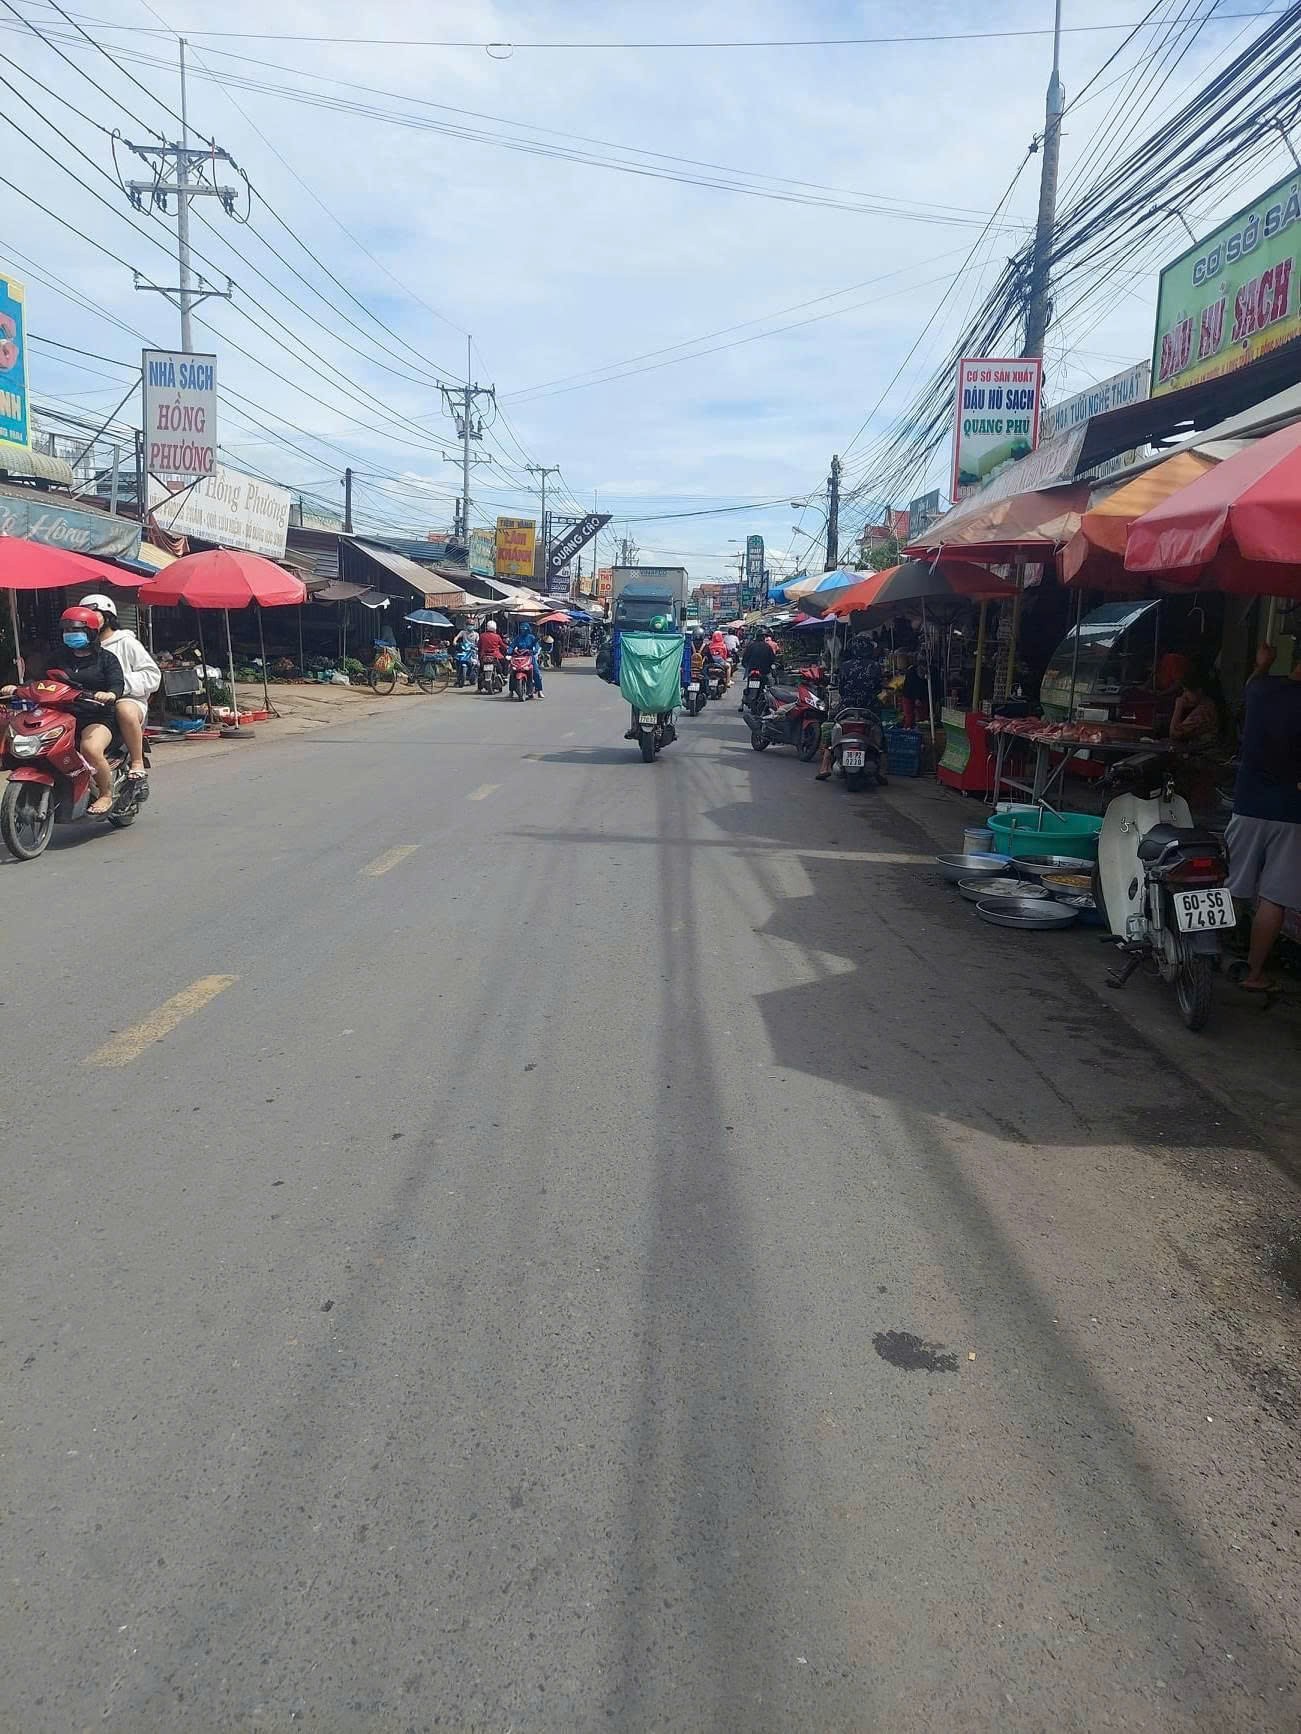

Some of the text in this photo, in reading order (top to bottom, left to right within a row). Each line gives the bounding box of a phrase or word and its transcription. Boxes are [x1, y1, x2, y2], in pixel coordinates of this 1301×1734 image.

[1231, 257, 1293, 350] SẠCH
[149, 357, 214, 391] NHÀ SÁCH
[156, 391, 206, 433] HỒNG
[1005, 388, 1035, 414] SẠCH
[963, 418, 1003, 437] QUANG
[149, 439, 214, 473] PHƯƠNG
[204, 468, 288, 528] Hồng Phương
[552, 517, 600, 567] QUẢNG CÁO
[1183, 892, 1224, 911] 60-S6
[1185, 909, 1227, 928] 7482
